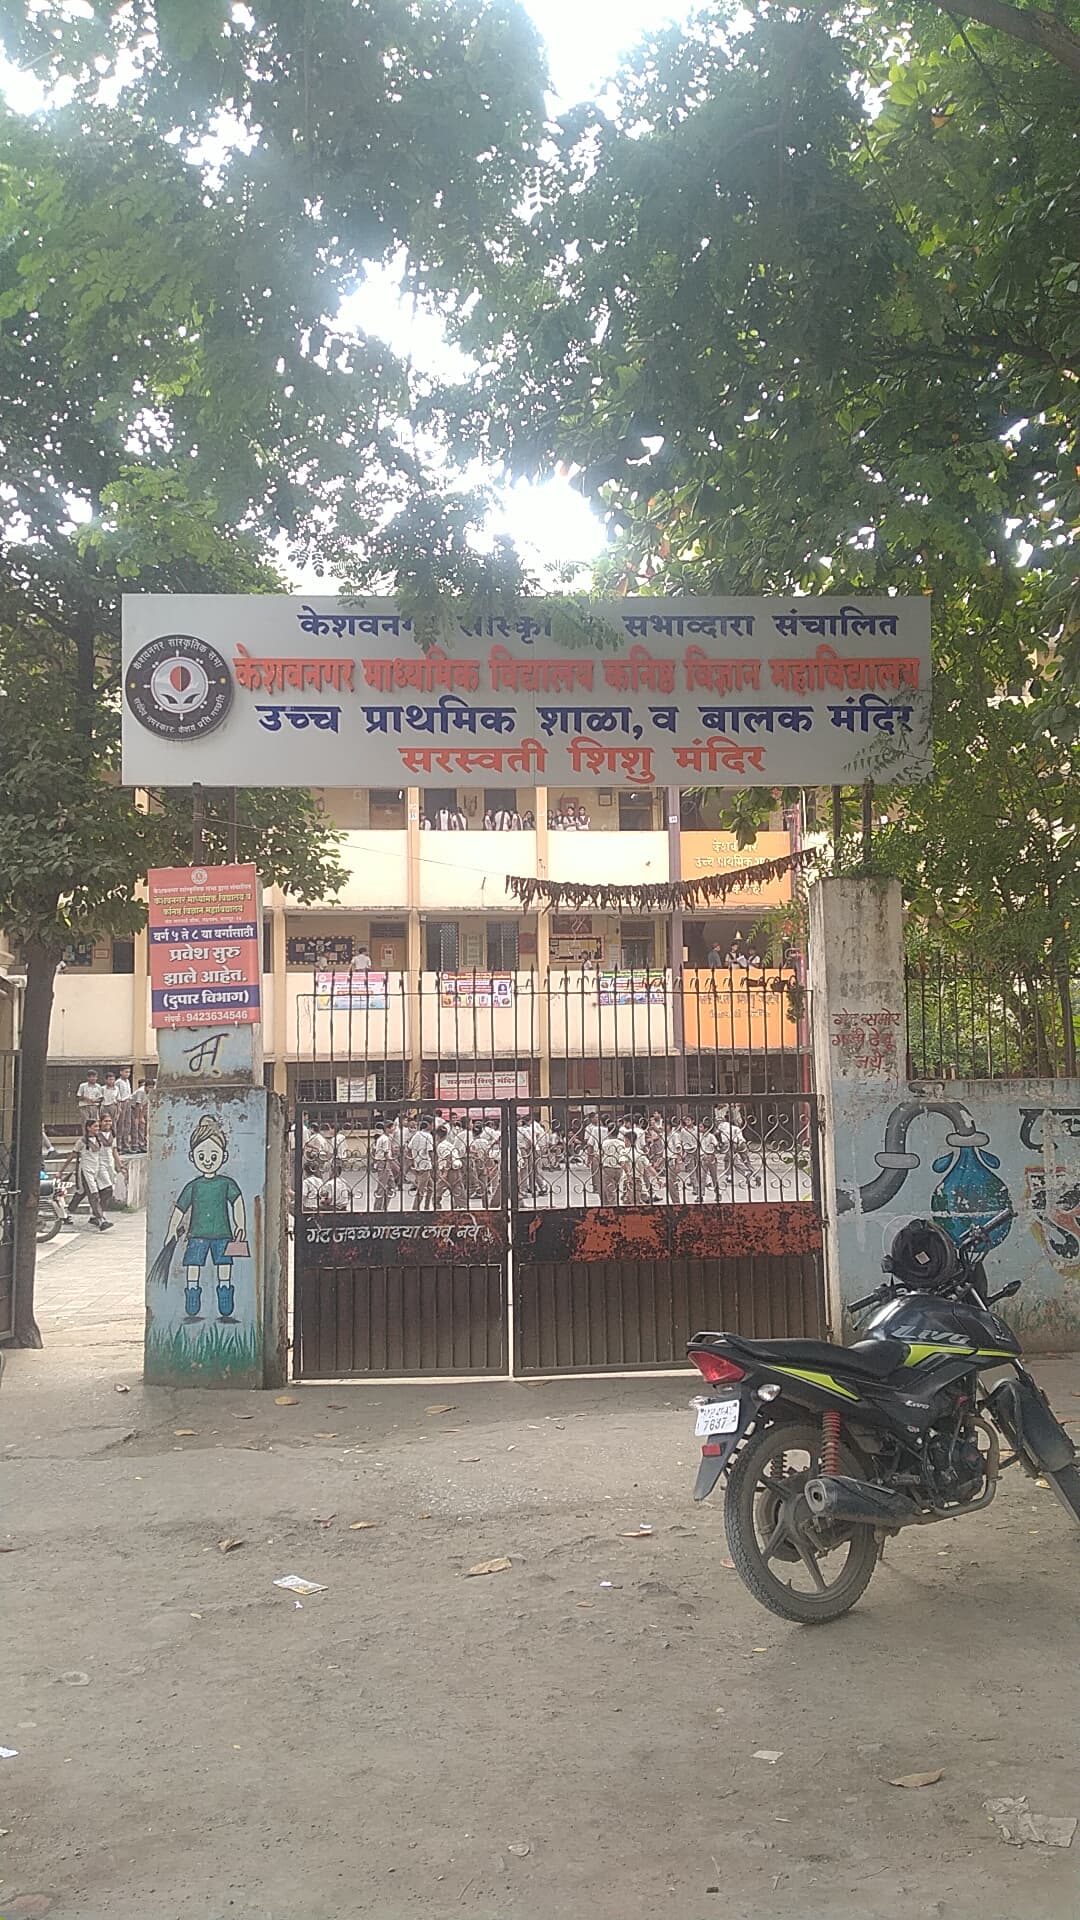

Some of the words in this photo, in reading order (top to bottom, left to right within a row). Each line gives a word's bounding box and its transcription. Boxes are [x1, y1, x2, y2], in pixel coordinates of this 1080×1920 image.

[772, 606, 899, 637] संचालित
[233, 642, 355, 694] केशवनगर
[361, 645, 480, 693] माध्यमिक
[489, 645, 593, 693] विद्यालय
[601, 645, 676, 693] कनिष्ठ
[684, 645, 761, 695] विज्ञान
[768, 644, 920, 695] महाविद्यालय
[255, 705, 342, 733] उच्च
[361, 695, 517, 734] प्राथमिक
[698, 706, 813, 733] बालक
[828, 693, 914, 735] मंदिर
[398, 738, 549, 774] सरस्वती
[566, 738, 656, 784] शिशु
[672, 737, 767, 774] मंदिर
[153, 928, 169, 941] वर्ग
[181, 929, 189, 940] ते
[201, 929, 212, 939] या
[169, 944, 209, 961] प्रवेश
[212, 946, 240, 964] सुरु
[163, 967, 197, 985] झाले
[200, 966, 247, 984] आहेत.
[163, 993, 200, 1010] (दुपार
[202, 989, 249, 1005] विभाग)
[186, 1010, 248, 1022] 9423634546
